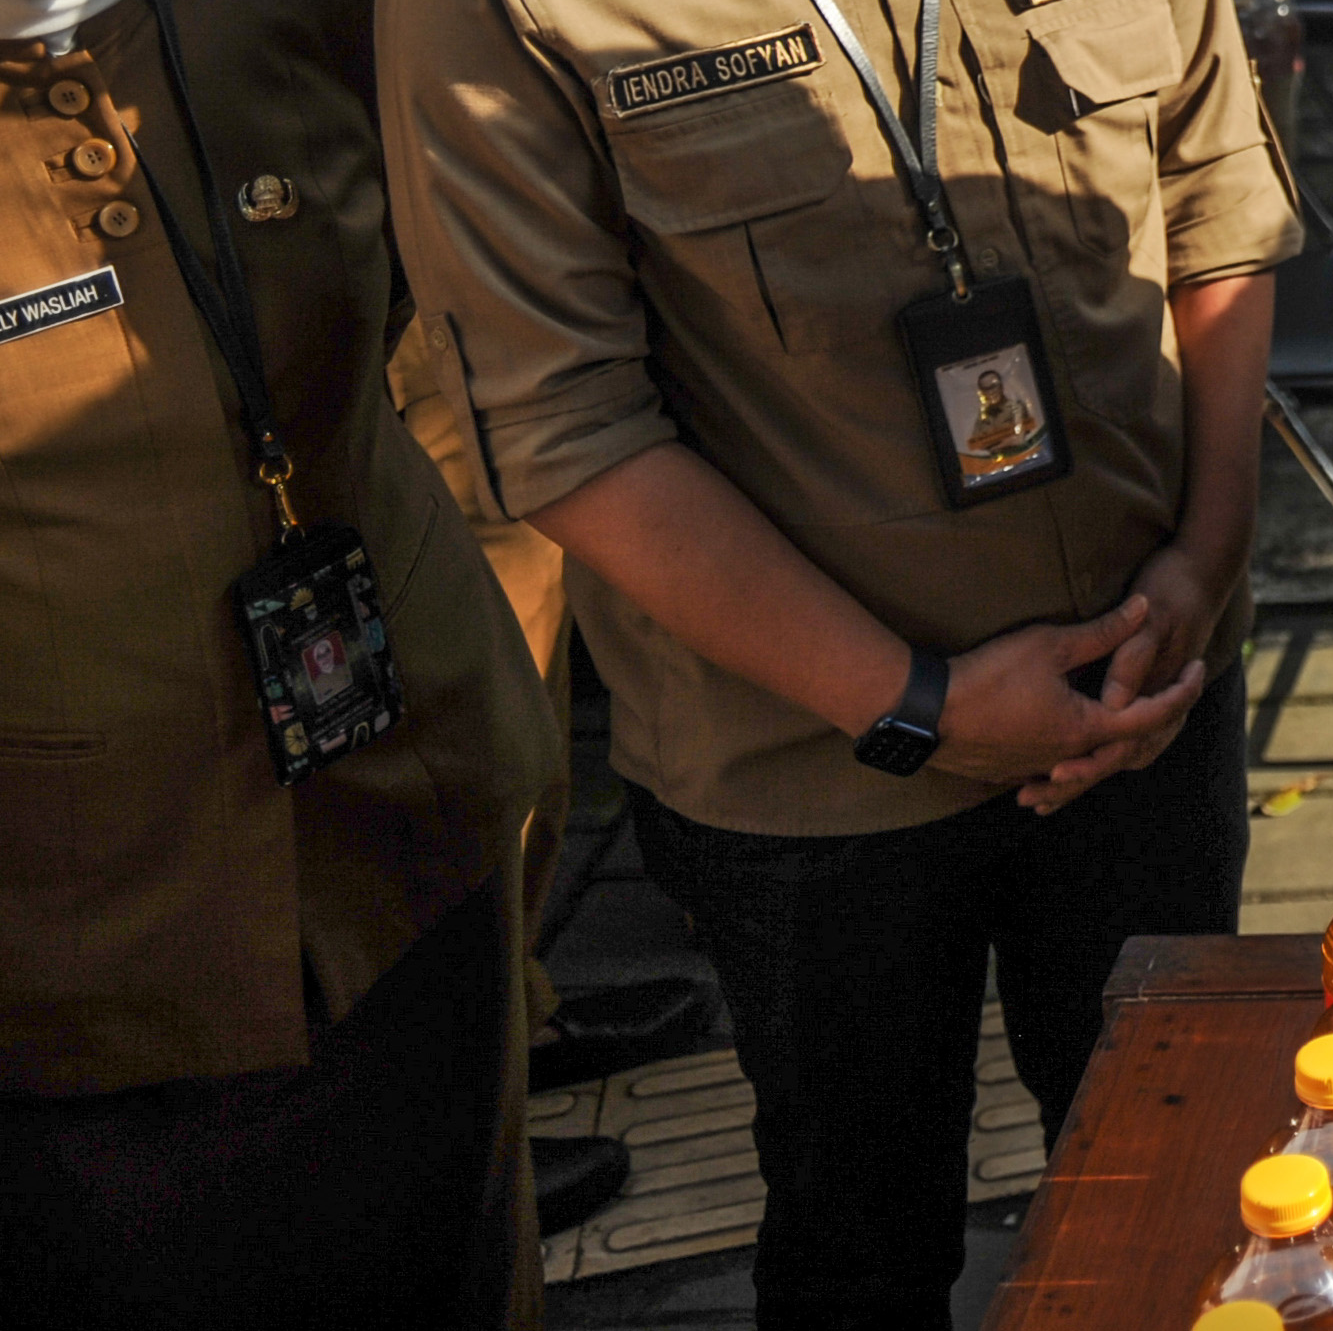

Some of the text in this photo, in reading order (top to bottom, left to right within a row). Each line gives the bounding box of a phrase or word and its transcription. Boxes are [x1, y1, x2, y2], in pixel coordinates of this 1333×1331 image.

[622, 35, 808, 107] IENDRA SOFYAN
[0, 284, 99, 333] LY WASLIAH
